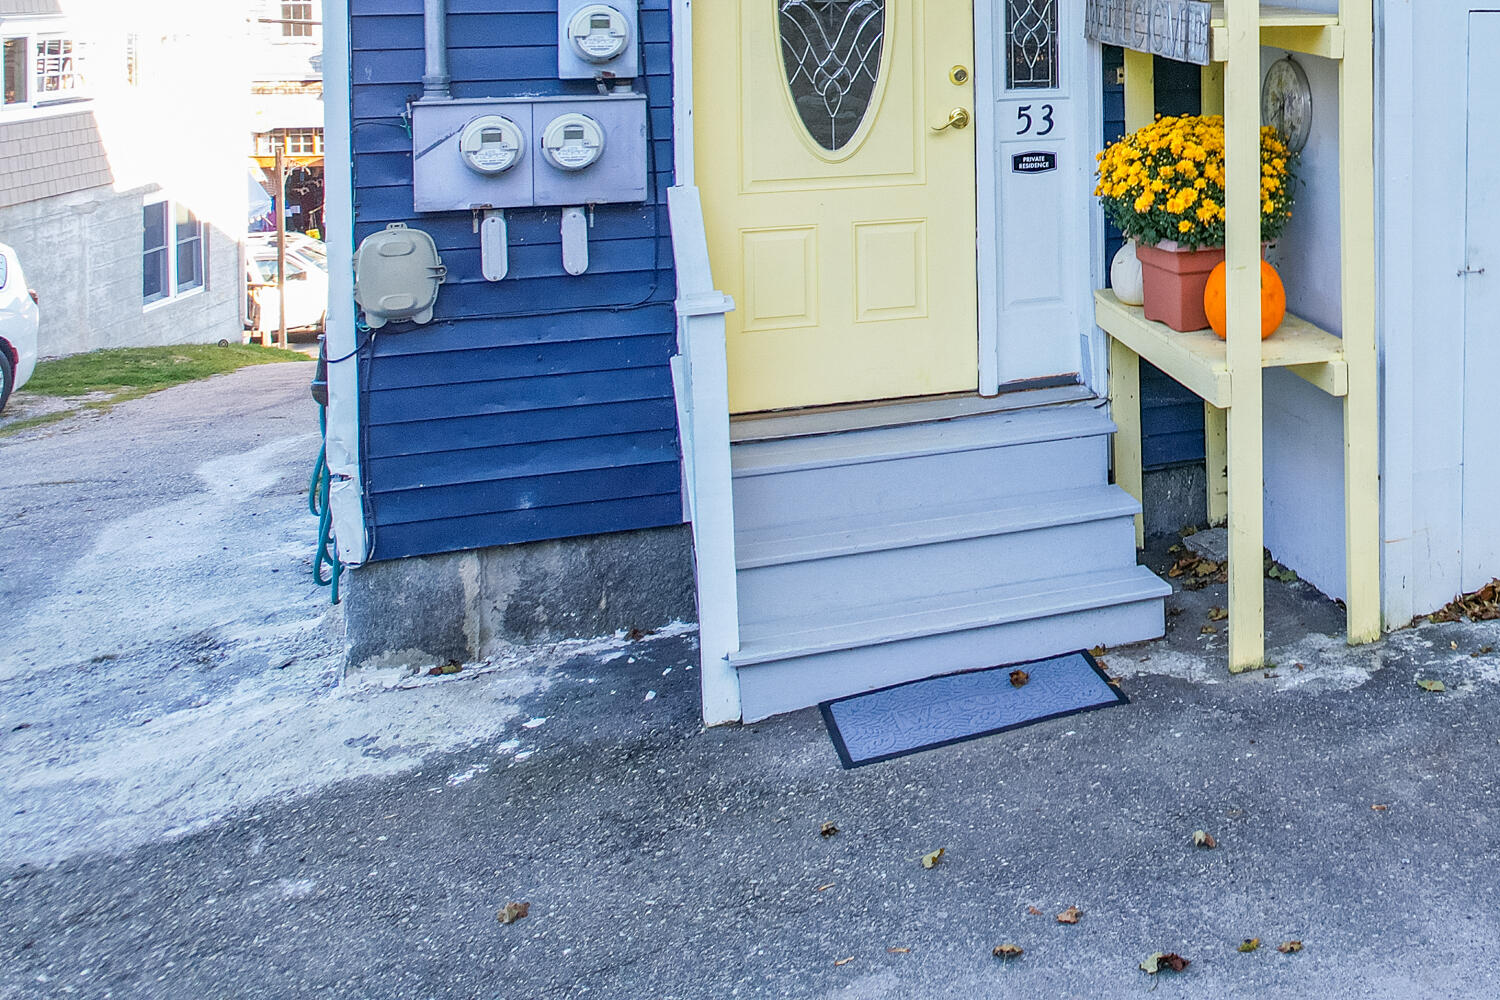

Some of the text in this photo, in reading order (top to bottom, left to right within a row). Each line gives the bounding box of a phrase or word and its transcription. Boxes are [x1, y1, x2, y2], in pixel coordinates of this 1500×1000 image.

[1016, 104, 1055, 135] 53
[1022, 155, 1046, 163] PRIVATE
[1018, 161, 1050, 170] RESIDENCE
